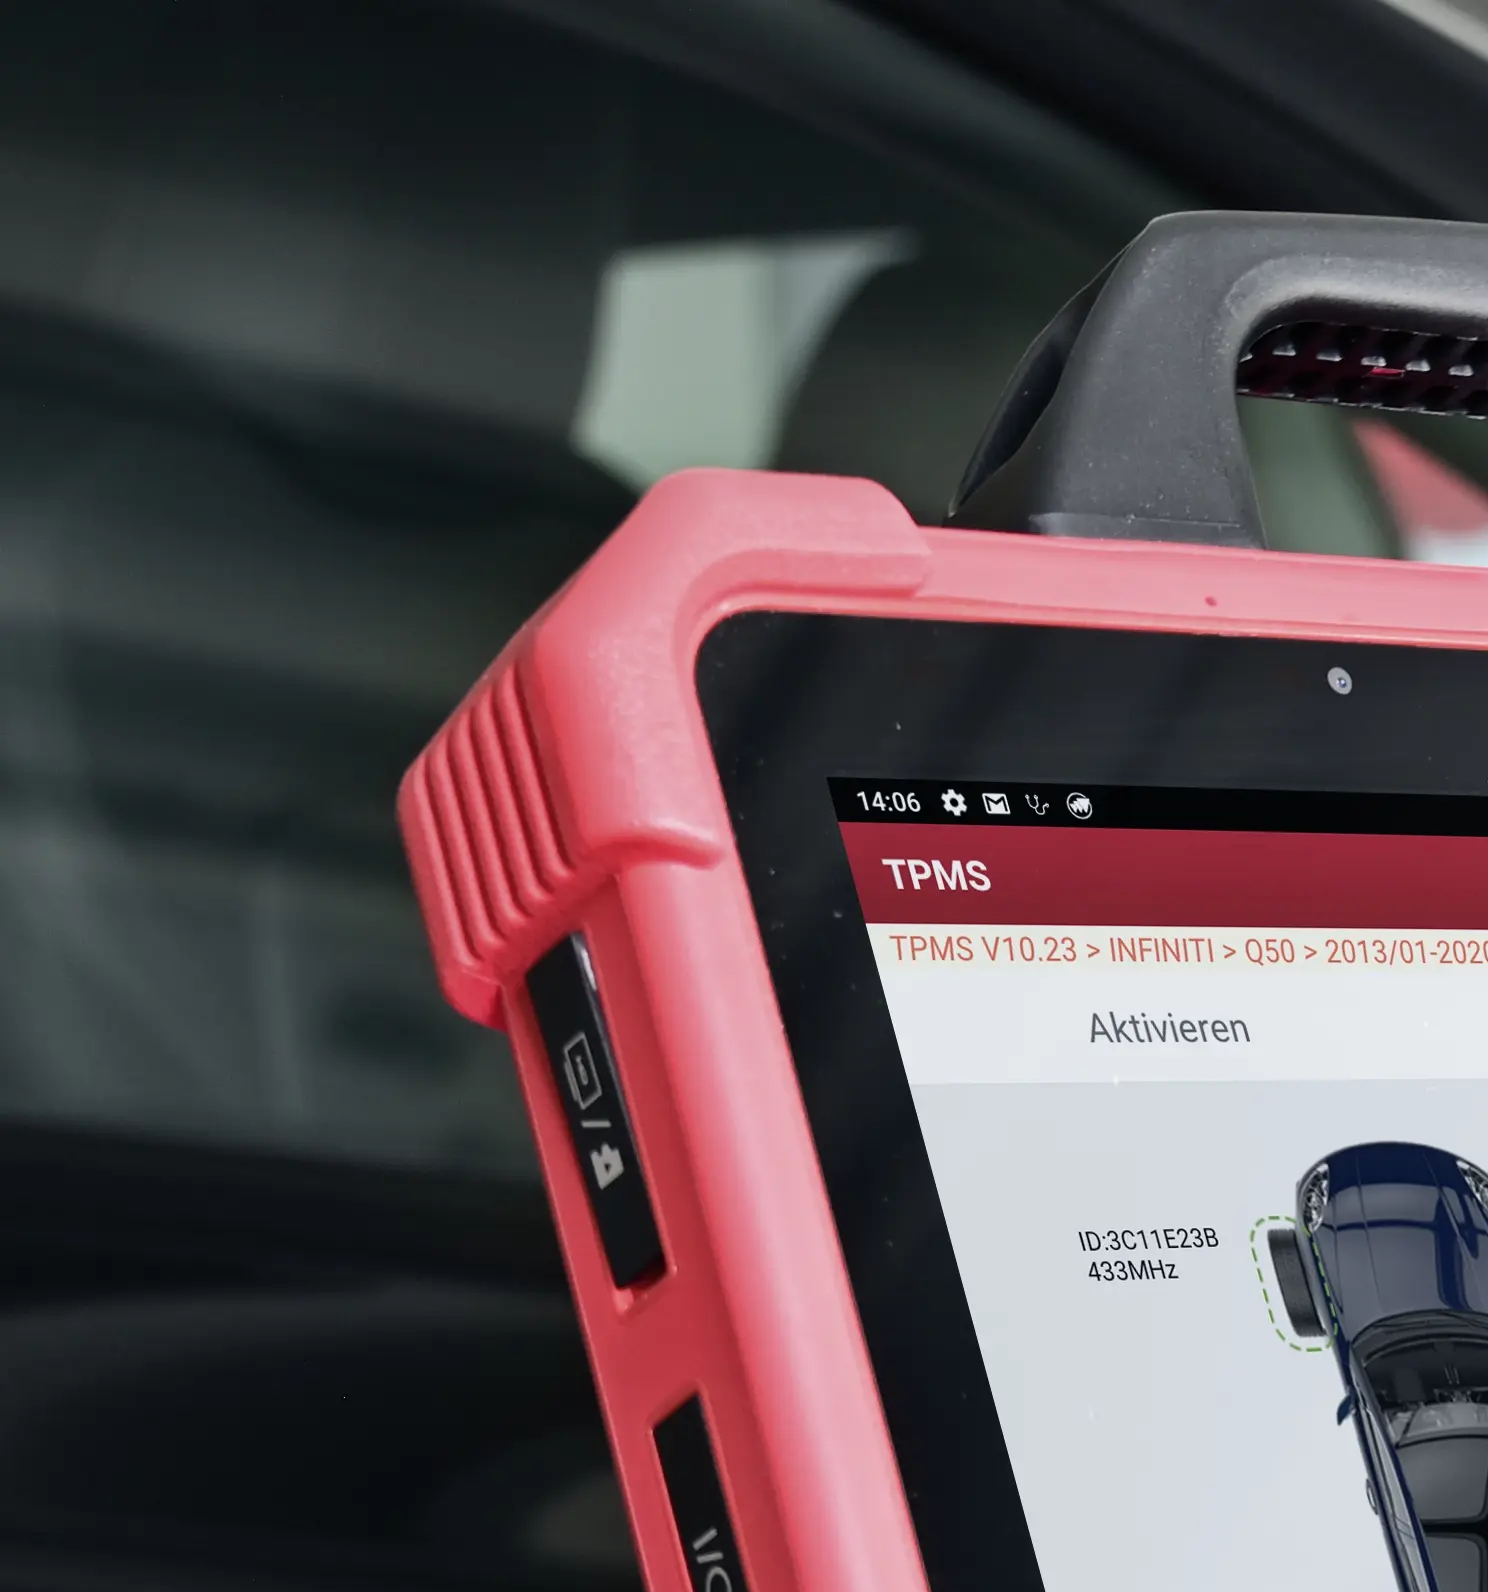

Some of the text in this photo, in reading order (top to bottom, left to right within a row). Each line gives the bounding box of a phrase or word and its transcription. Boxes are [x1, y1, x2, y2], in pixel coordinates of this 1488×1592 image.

[857, 791, 920, 812] 14:06
[882, 859, 991, 891] TPMS
[889, 936, 973, 961] TPMS
[981, 937, 1076, 961] V10.23
[1110, 938, 1213, 962] INFINITI
[1246, 939, 1294, 966] Q50
[1091, 1012, 1250, 1043] Aktivieren
[1079, 1228, 1218, 1251] ID:3C11E23B
[1089, 1260, 1179, 1281] 433MHz
